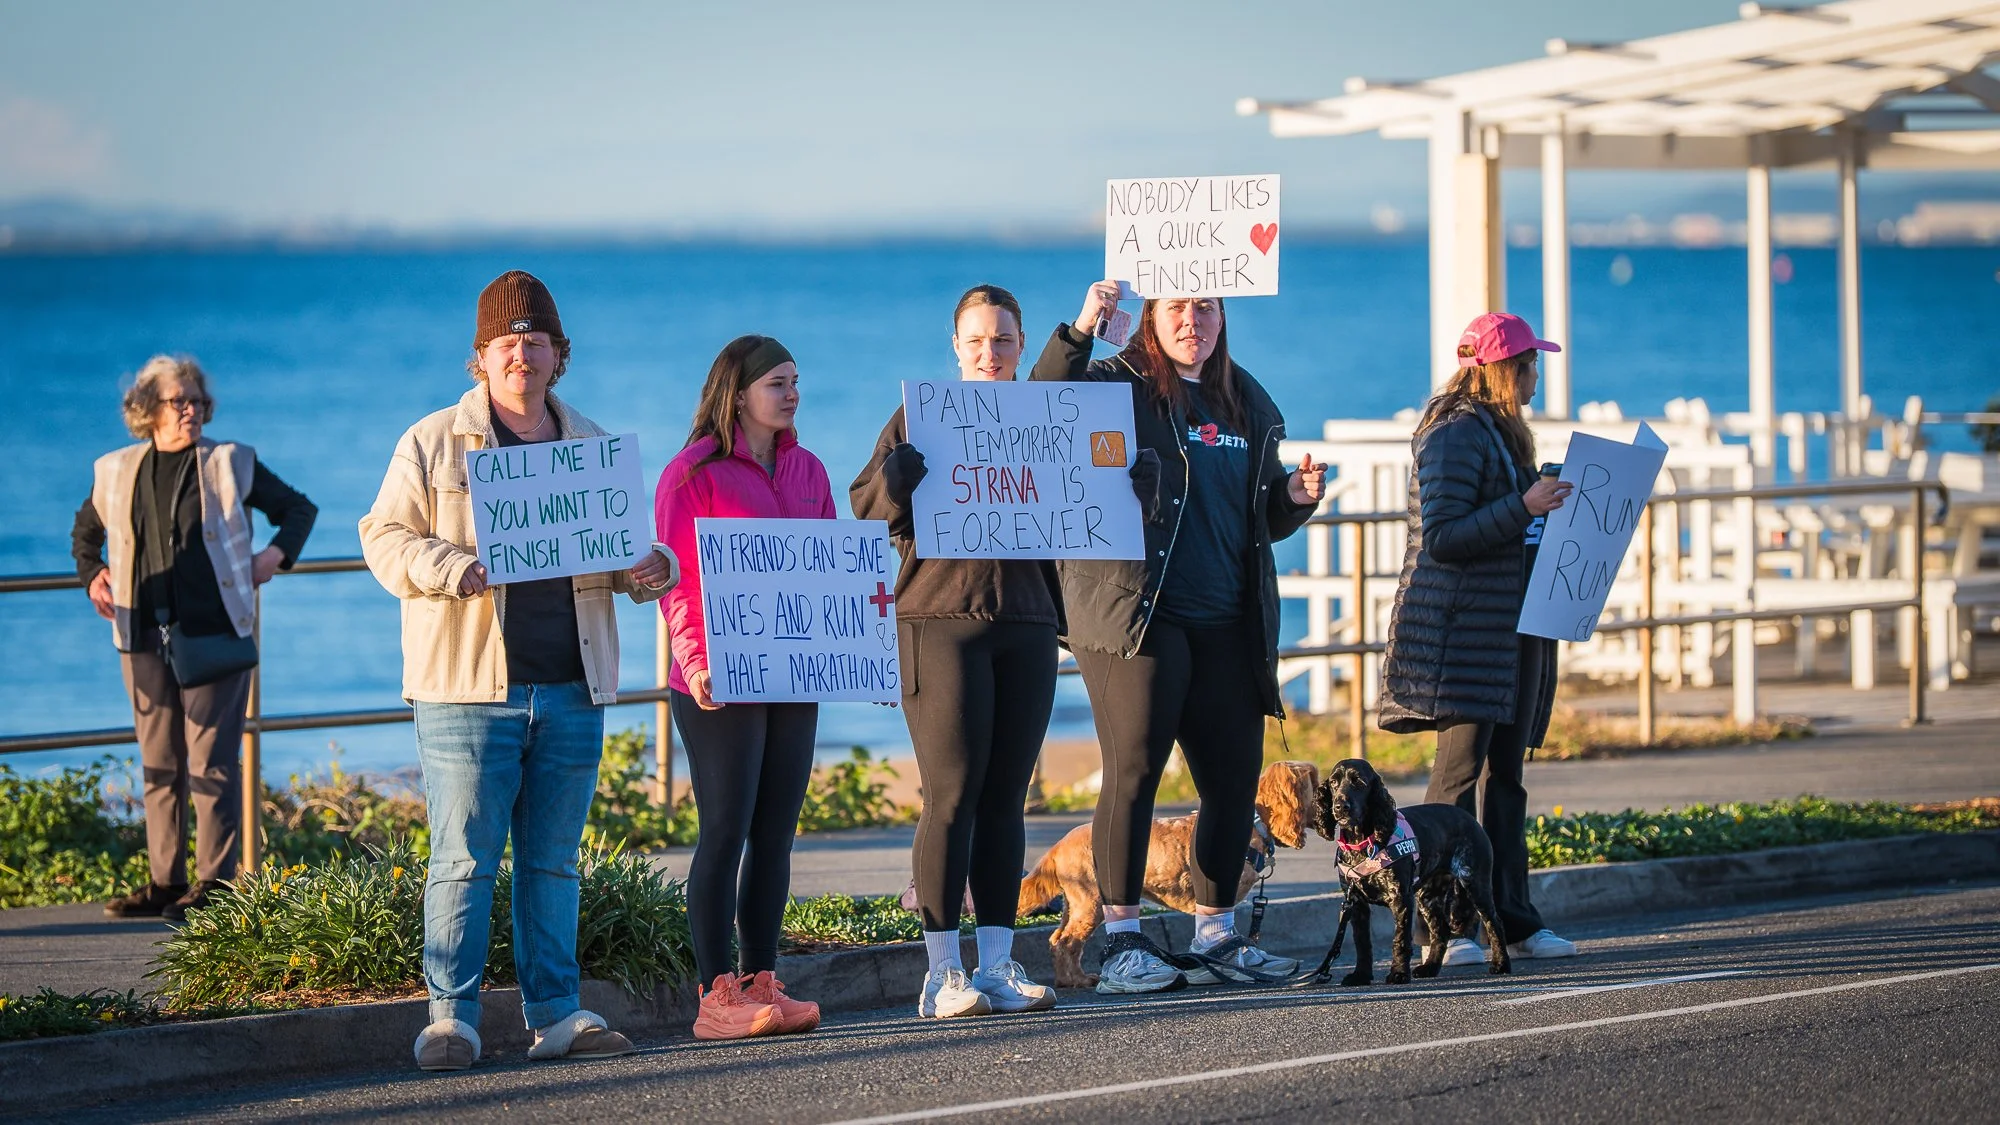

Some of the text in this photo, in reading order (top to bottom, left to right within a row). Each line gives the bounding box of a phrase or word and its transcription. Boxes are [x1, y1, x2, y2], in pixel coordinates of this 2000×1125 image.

[1110, 178, 1270, 216] NOBODY LIKES
[1119, 220, 1225, 254] A QUICK
[1136, 253, 1255, 293] FINISHER
[918, 382, 1080, 424] PAIN IS
[474, 437, 622, 483] CALL ME IF
[952, 424, 1074, 463] TEMPORARY
[952, 464, 1085, 504] STRAVA IS
[483, 487, 629, 534] YOU WANT TO
[488, 527, 634, 574] FINISH TWICE
[699, 532, 886, 575] MY FRIENDS CAN SAVE
[707, 591, 865, 640] LIVES AND RUN
[724, 651, 898, 695] HALF MARATHONS
